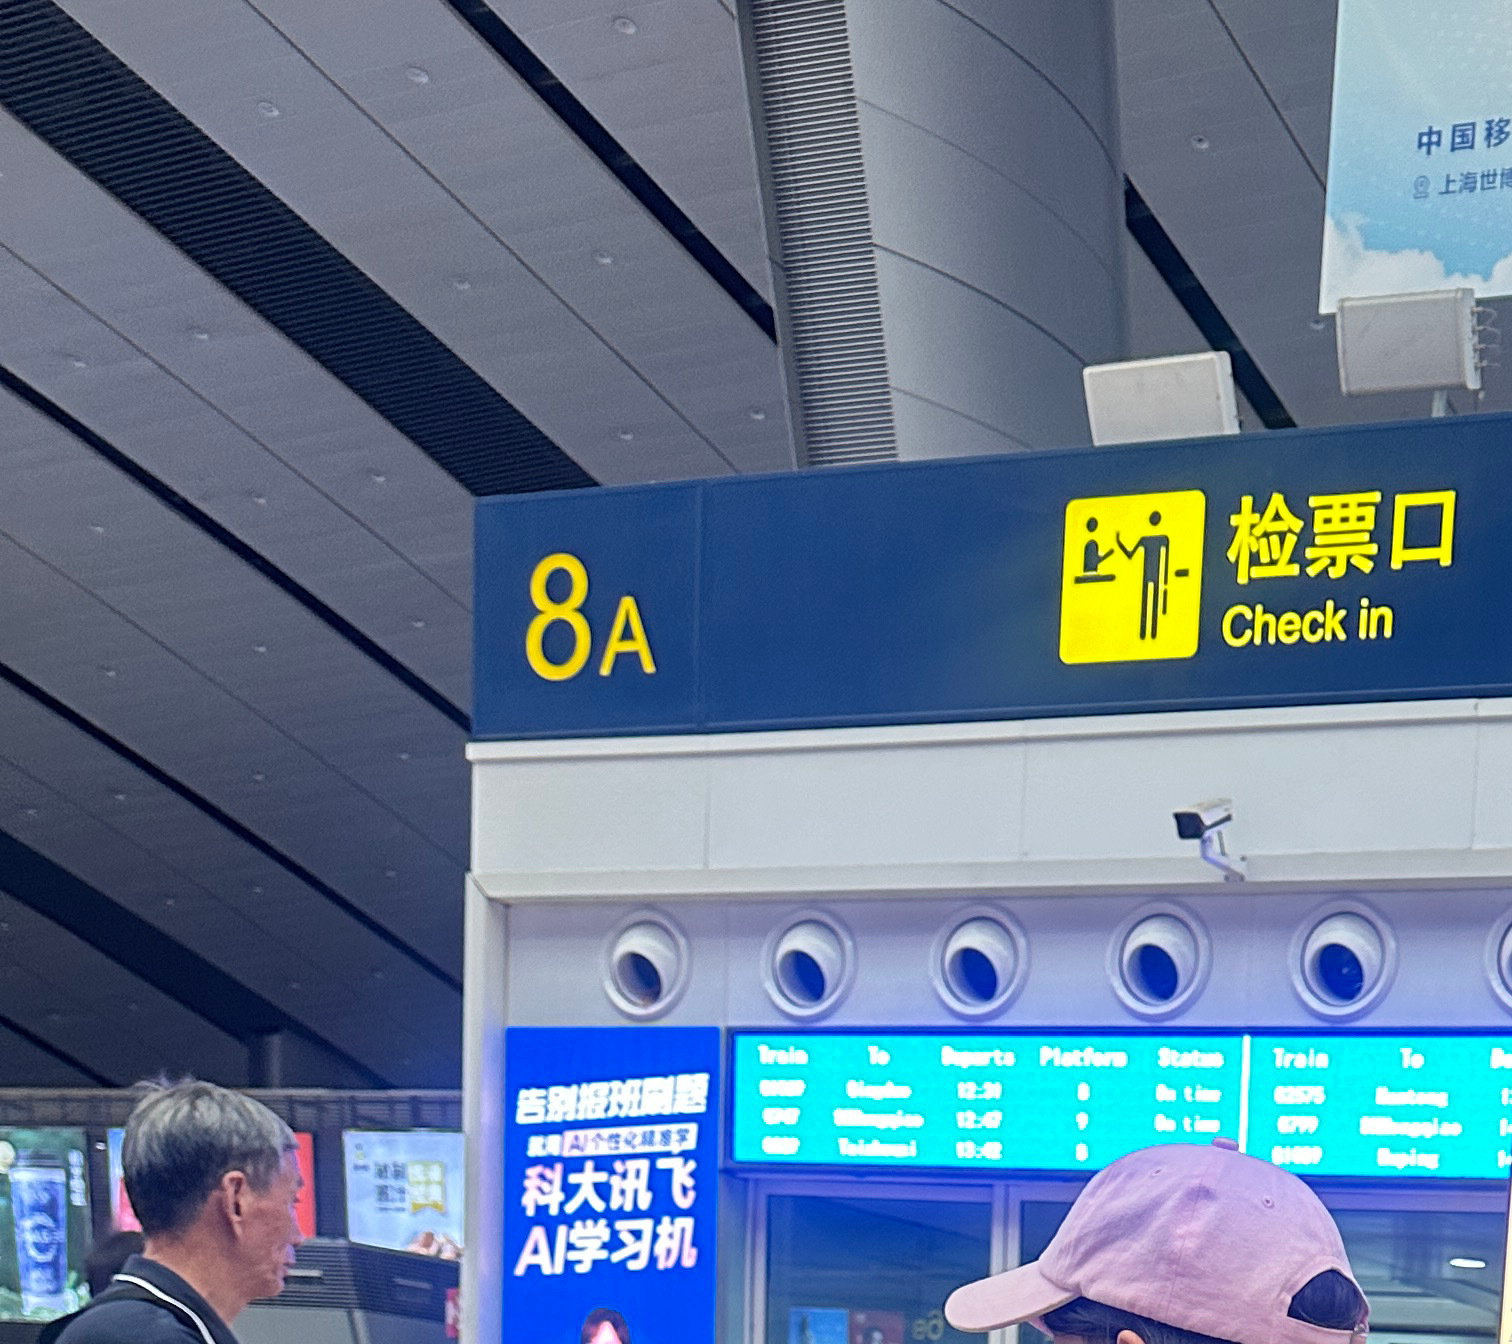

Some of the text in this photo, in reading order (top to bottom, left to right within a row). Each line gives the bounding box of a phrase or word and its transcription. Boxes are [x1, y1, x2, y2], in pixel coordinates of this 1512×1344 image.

[1226, 489, 1458, 586] 检票口
[525, 552, 657, 682] 8A
[1222, 598, 1394, 650] Check in
[759, 1044, 809, 1065] Train
[868, 1046, 890, 1066] To
[1039, 1046, 1127, 1068] Platform
[1273, 1047, 1329, 1069] Train
[1400, 1047, 1425, 1069] To
[521, 1156, 697, 1217] 科大讯飞
[513, 1215, 698, 1277] AI学习机
